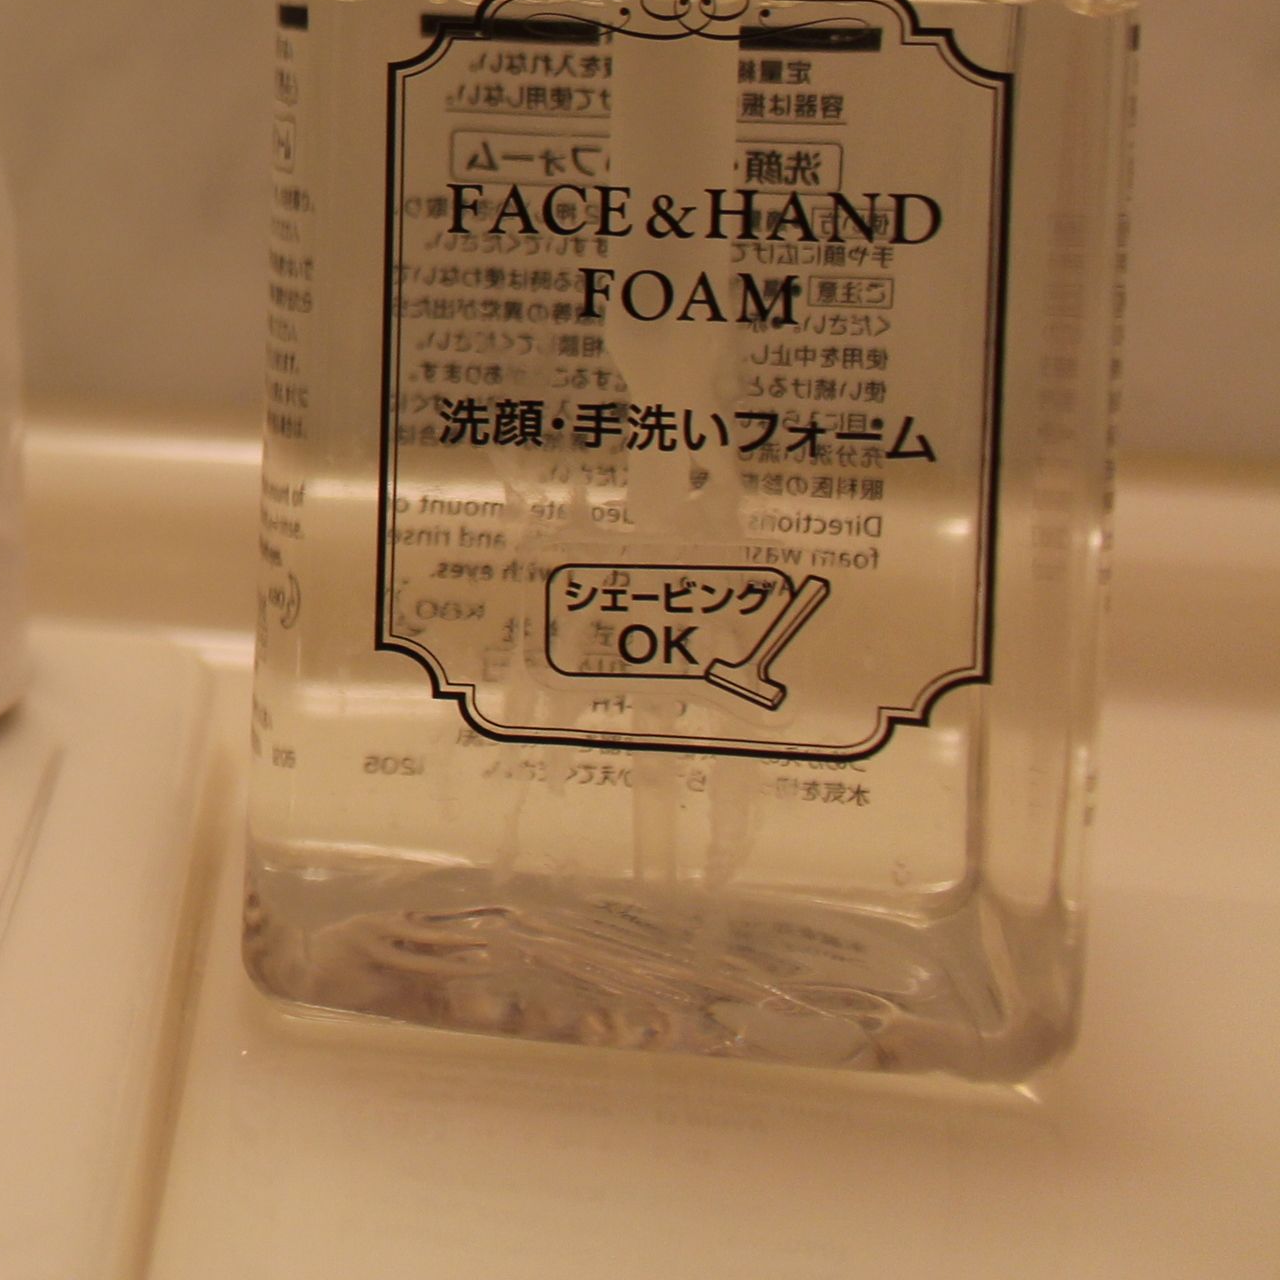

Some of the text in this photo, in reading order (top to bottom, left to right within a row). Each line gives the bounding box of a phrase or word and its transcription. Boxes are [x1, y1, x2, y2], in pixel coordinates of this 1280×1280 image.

[579, 268, 799, 326] FOAM
[440, 398, 937, 463] 洗顔・手洗いフォーム
[565, 582, 773, 613] シェービング
[617, 625, 699, 665] OK
